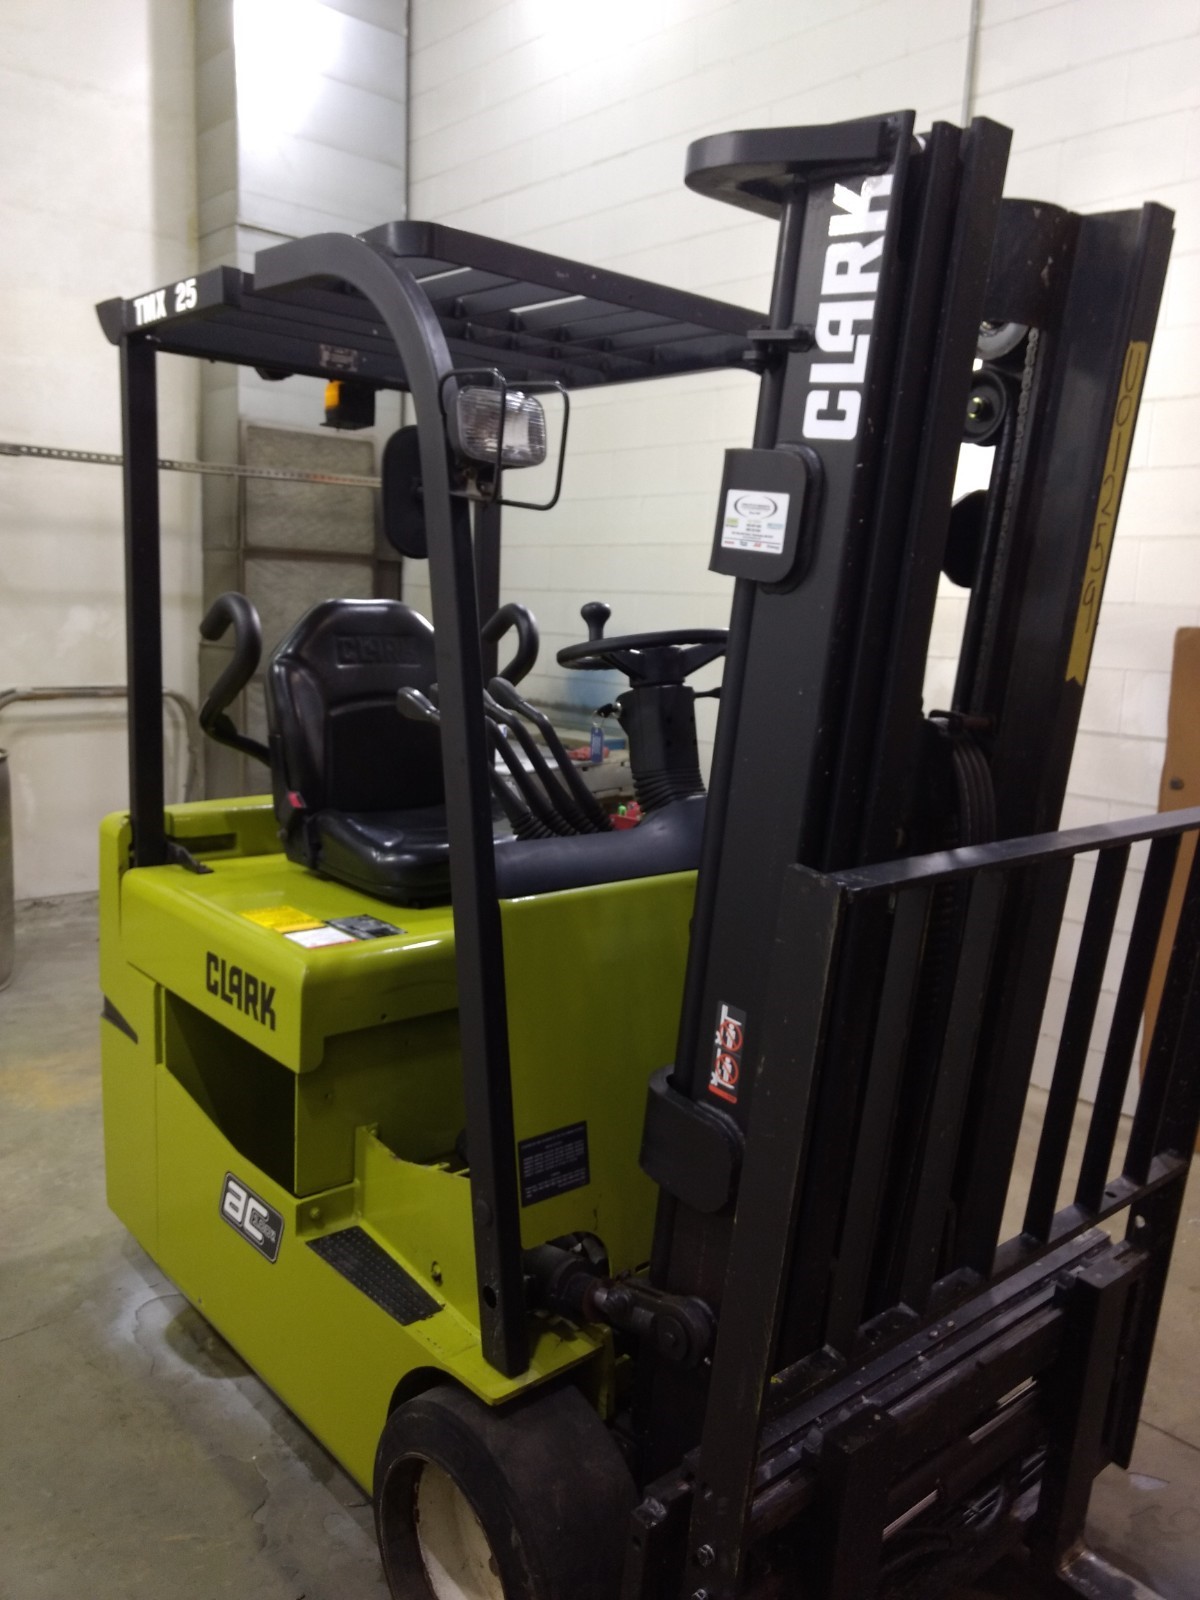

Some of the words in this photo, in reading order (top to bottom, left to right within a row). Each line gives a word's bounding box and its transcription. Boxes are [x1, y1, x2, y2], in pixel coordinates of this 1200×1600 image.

[133, 289, 168, 327] TMX
[175, 277, 198, 313] 25
[802, 174, 895, 441] CLARK
[206, 950, 276, 1032] CLARK
